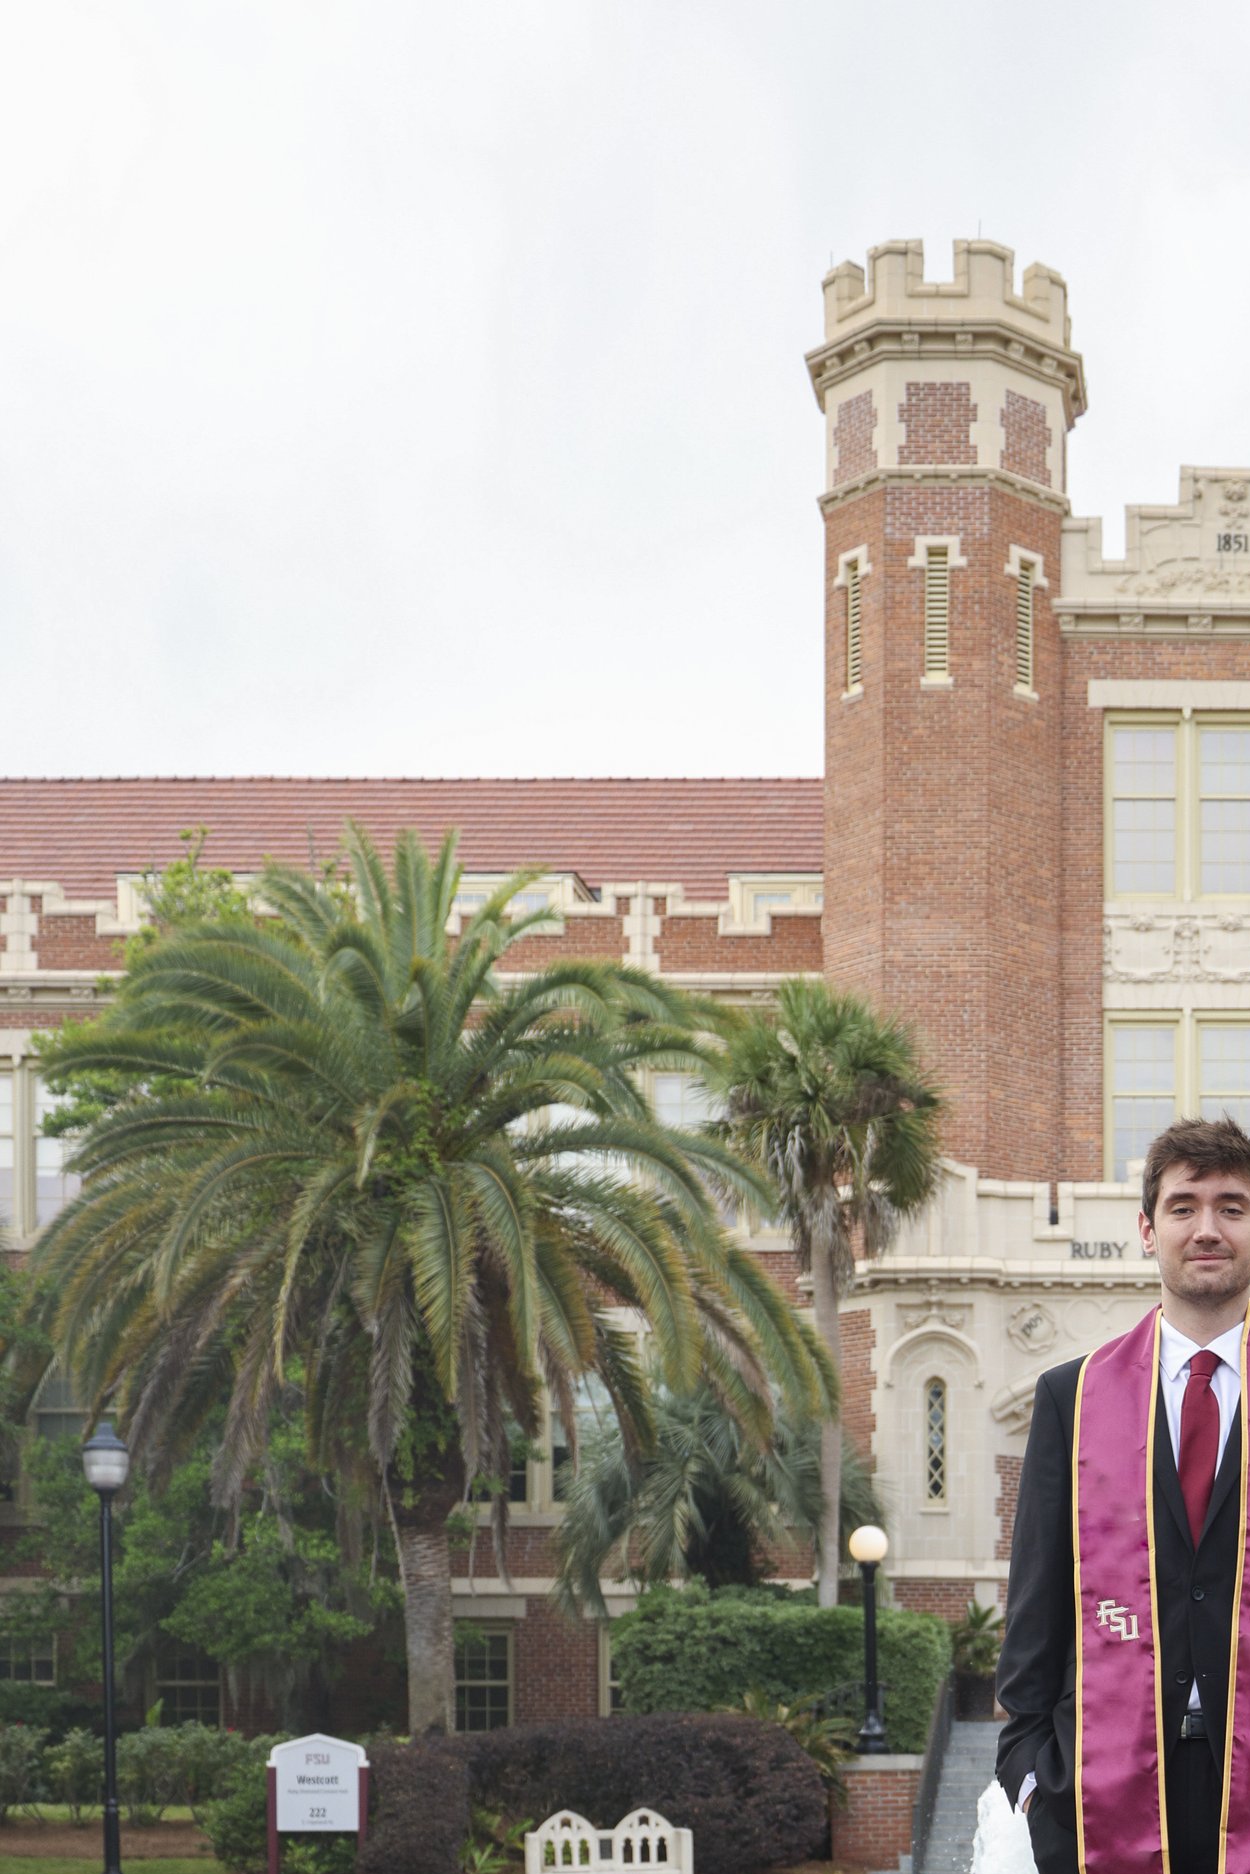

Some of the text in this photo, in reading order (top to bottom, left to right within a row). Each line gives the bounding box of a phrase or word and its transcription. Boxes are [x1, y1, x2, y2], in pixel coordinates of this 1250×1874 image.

[1216, 533, 1248, 552] 1851
[1071, 1241, 1128, 1258] RUBY
[1096, 1599, 1140, 1640] FSU
[305, 1753, 330, 1765] FSU
[296, 1775, 339, 1785] Westcott
[309, 1807, 327, 1818] 222
